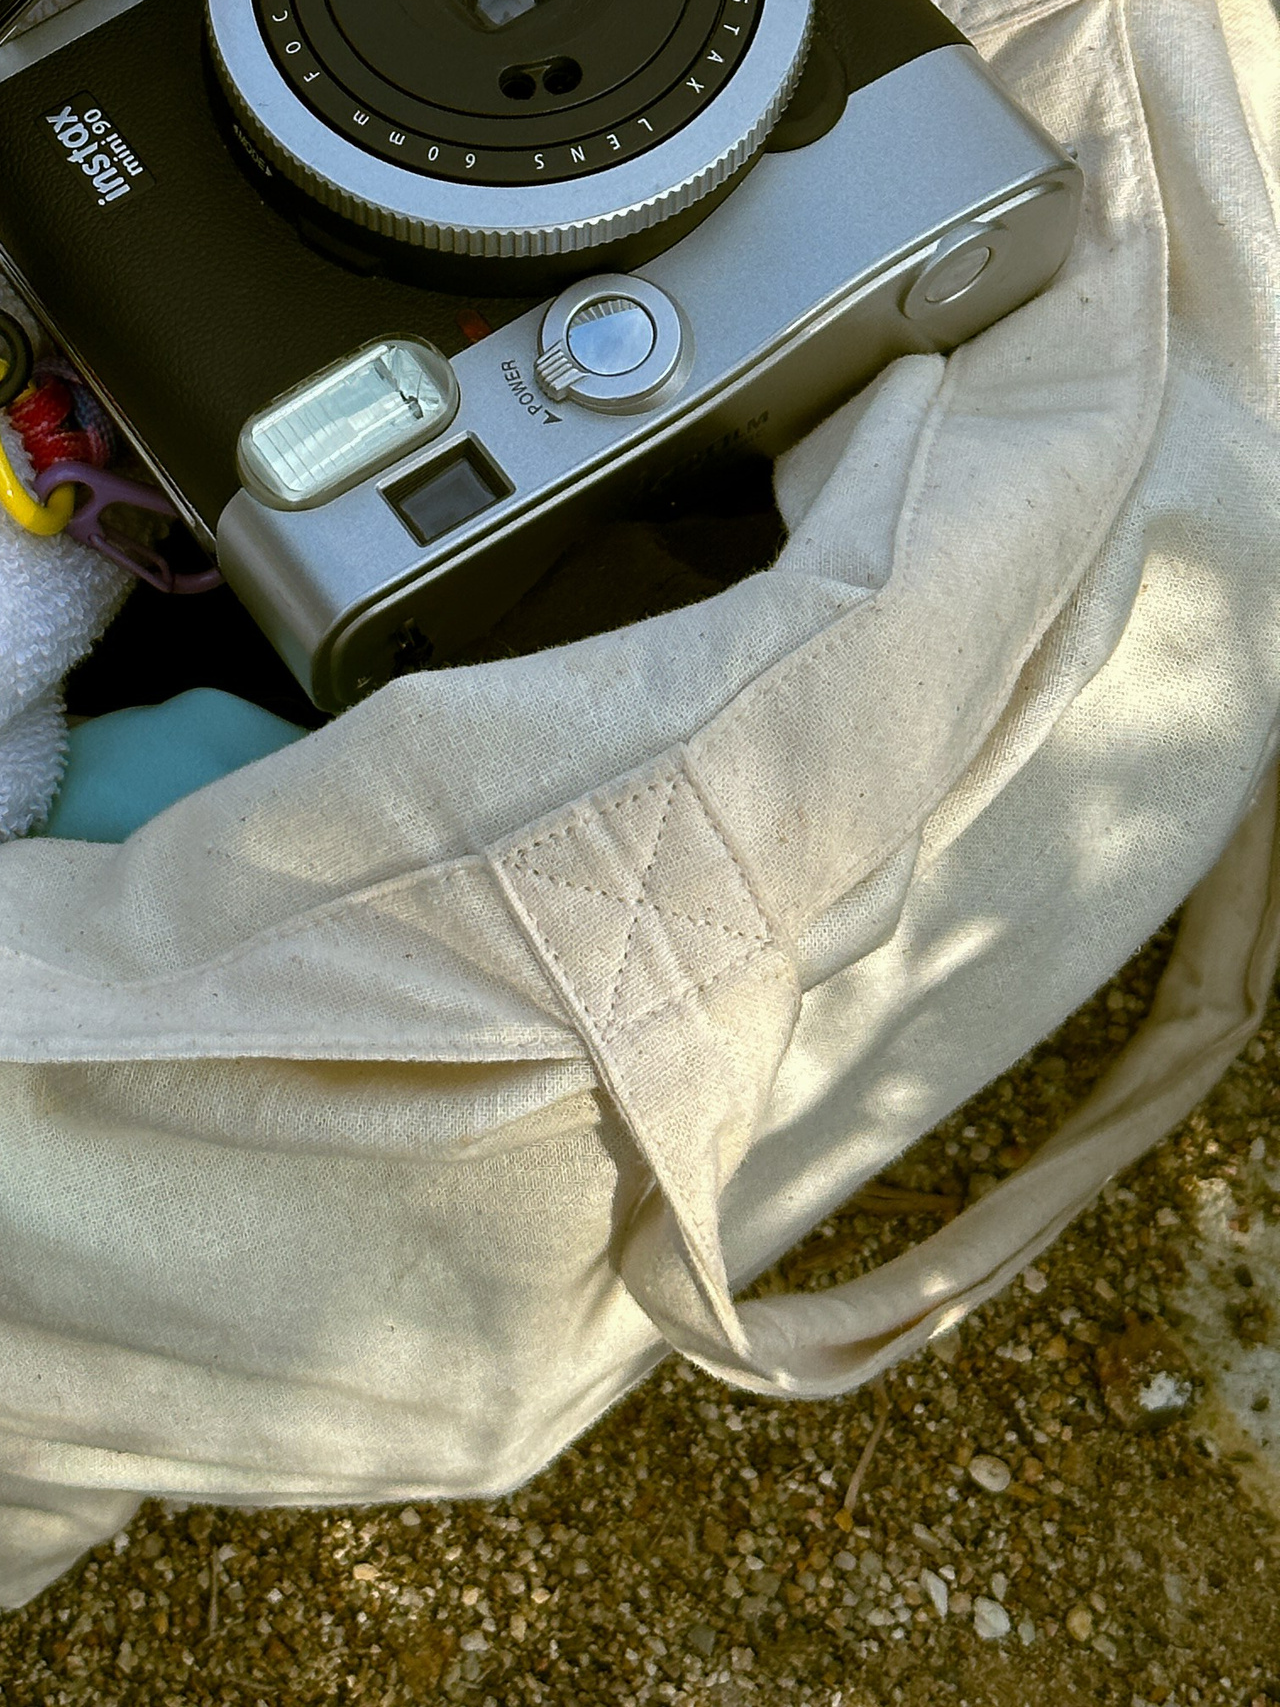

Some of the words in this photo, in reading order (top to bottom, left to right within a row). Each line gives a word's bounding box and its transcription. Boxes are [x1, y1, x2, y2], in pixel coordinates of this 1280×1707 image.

[84, 109, 111, 134] 90
[352, 109, 477, 169] 60mm
[534, 116, 655, 170] LENS
[46, 106, 131, 205] instax
[100, 133, 144, 176] mini
[501, 359, 543, 416] POWER
